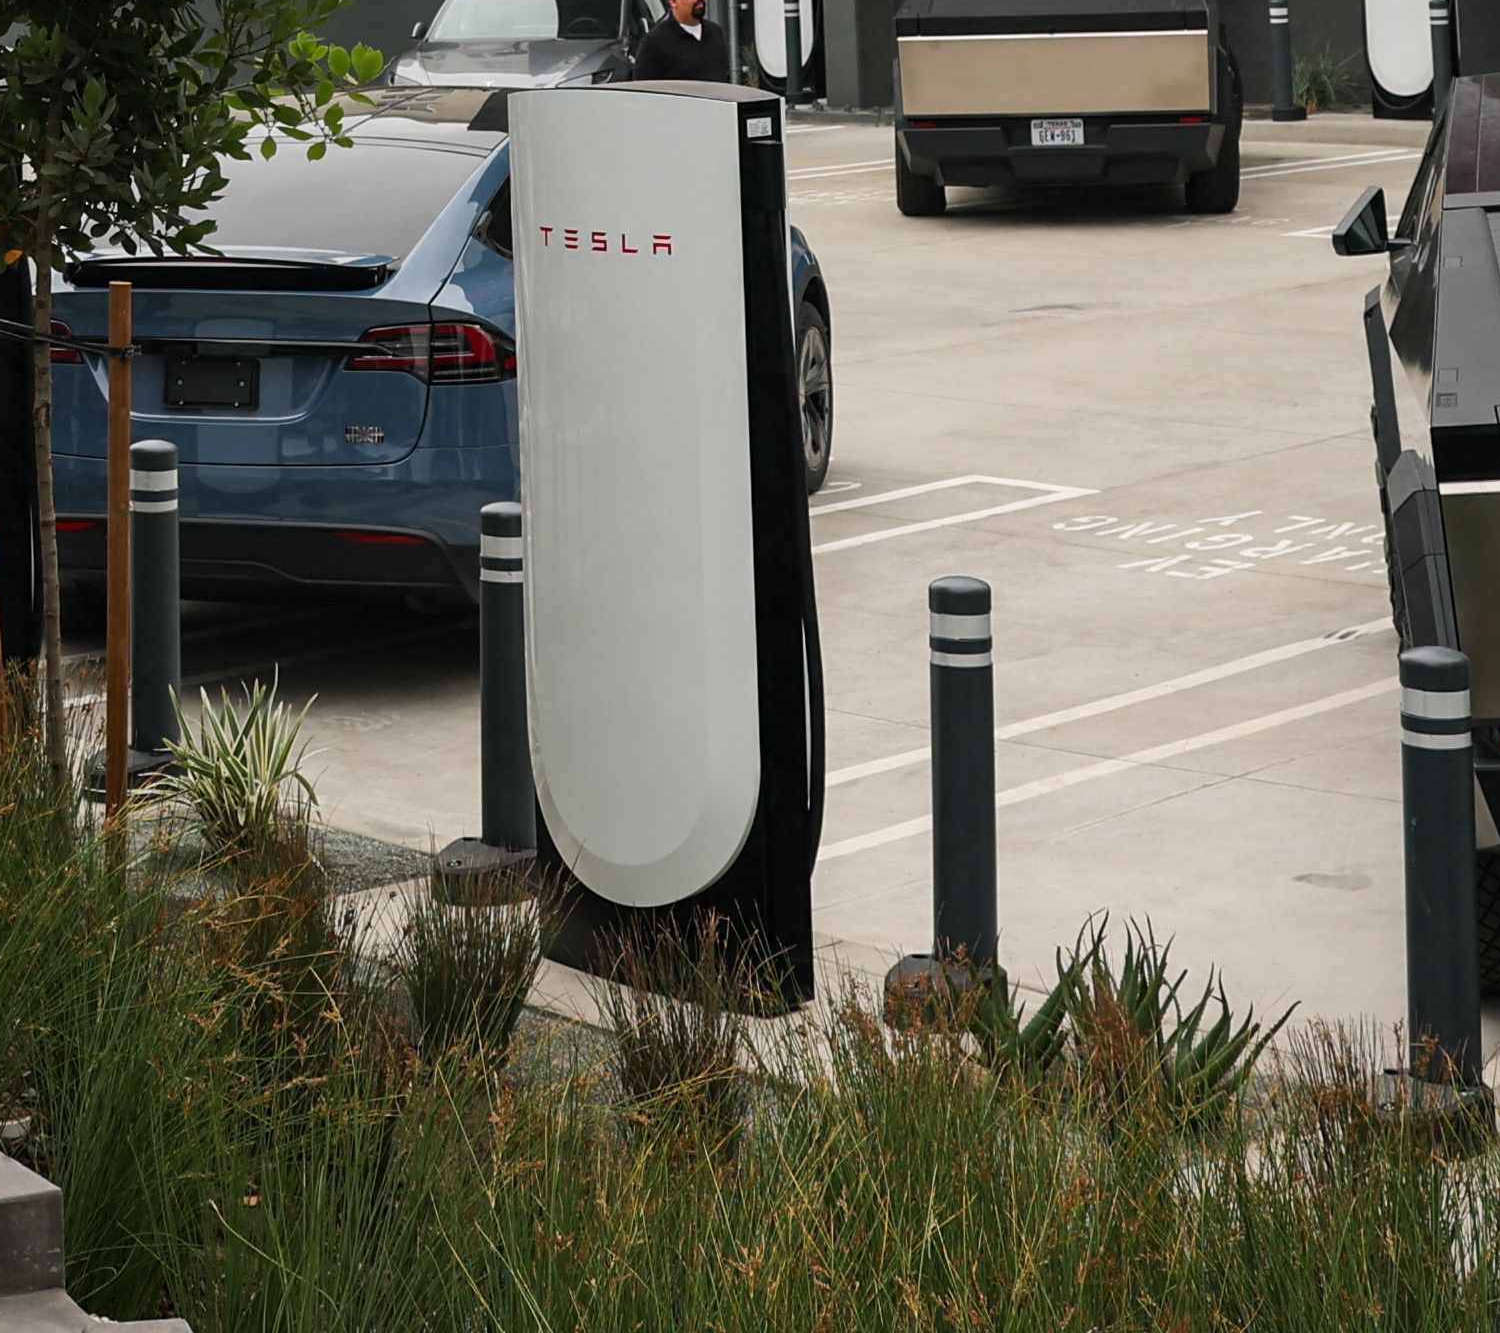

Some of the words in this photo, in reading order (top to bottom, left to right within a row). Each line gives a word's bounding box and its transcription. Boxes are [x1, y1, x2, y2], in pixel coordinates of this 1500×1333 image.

[539, 226, 672, 256] TESLA
[1052, 515, 1387, 575] ARGING
[1115, 553, 1256, 581] EV
